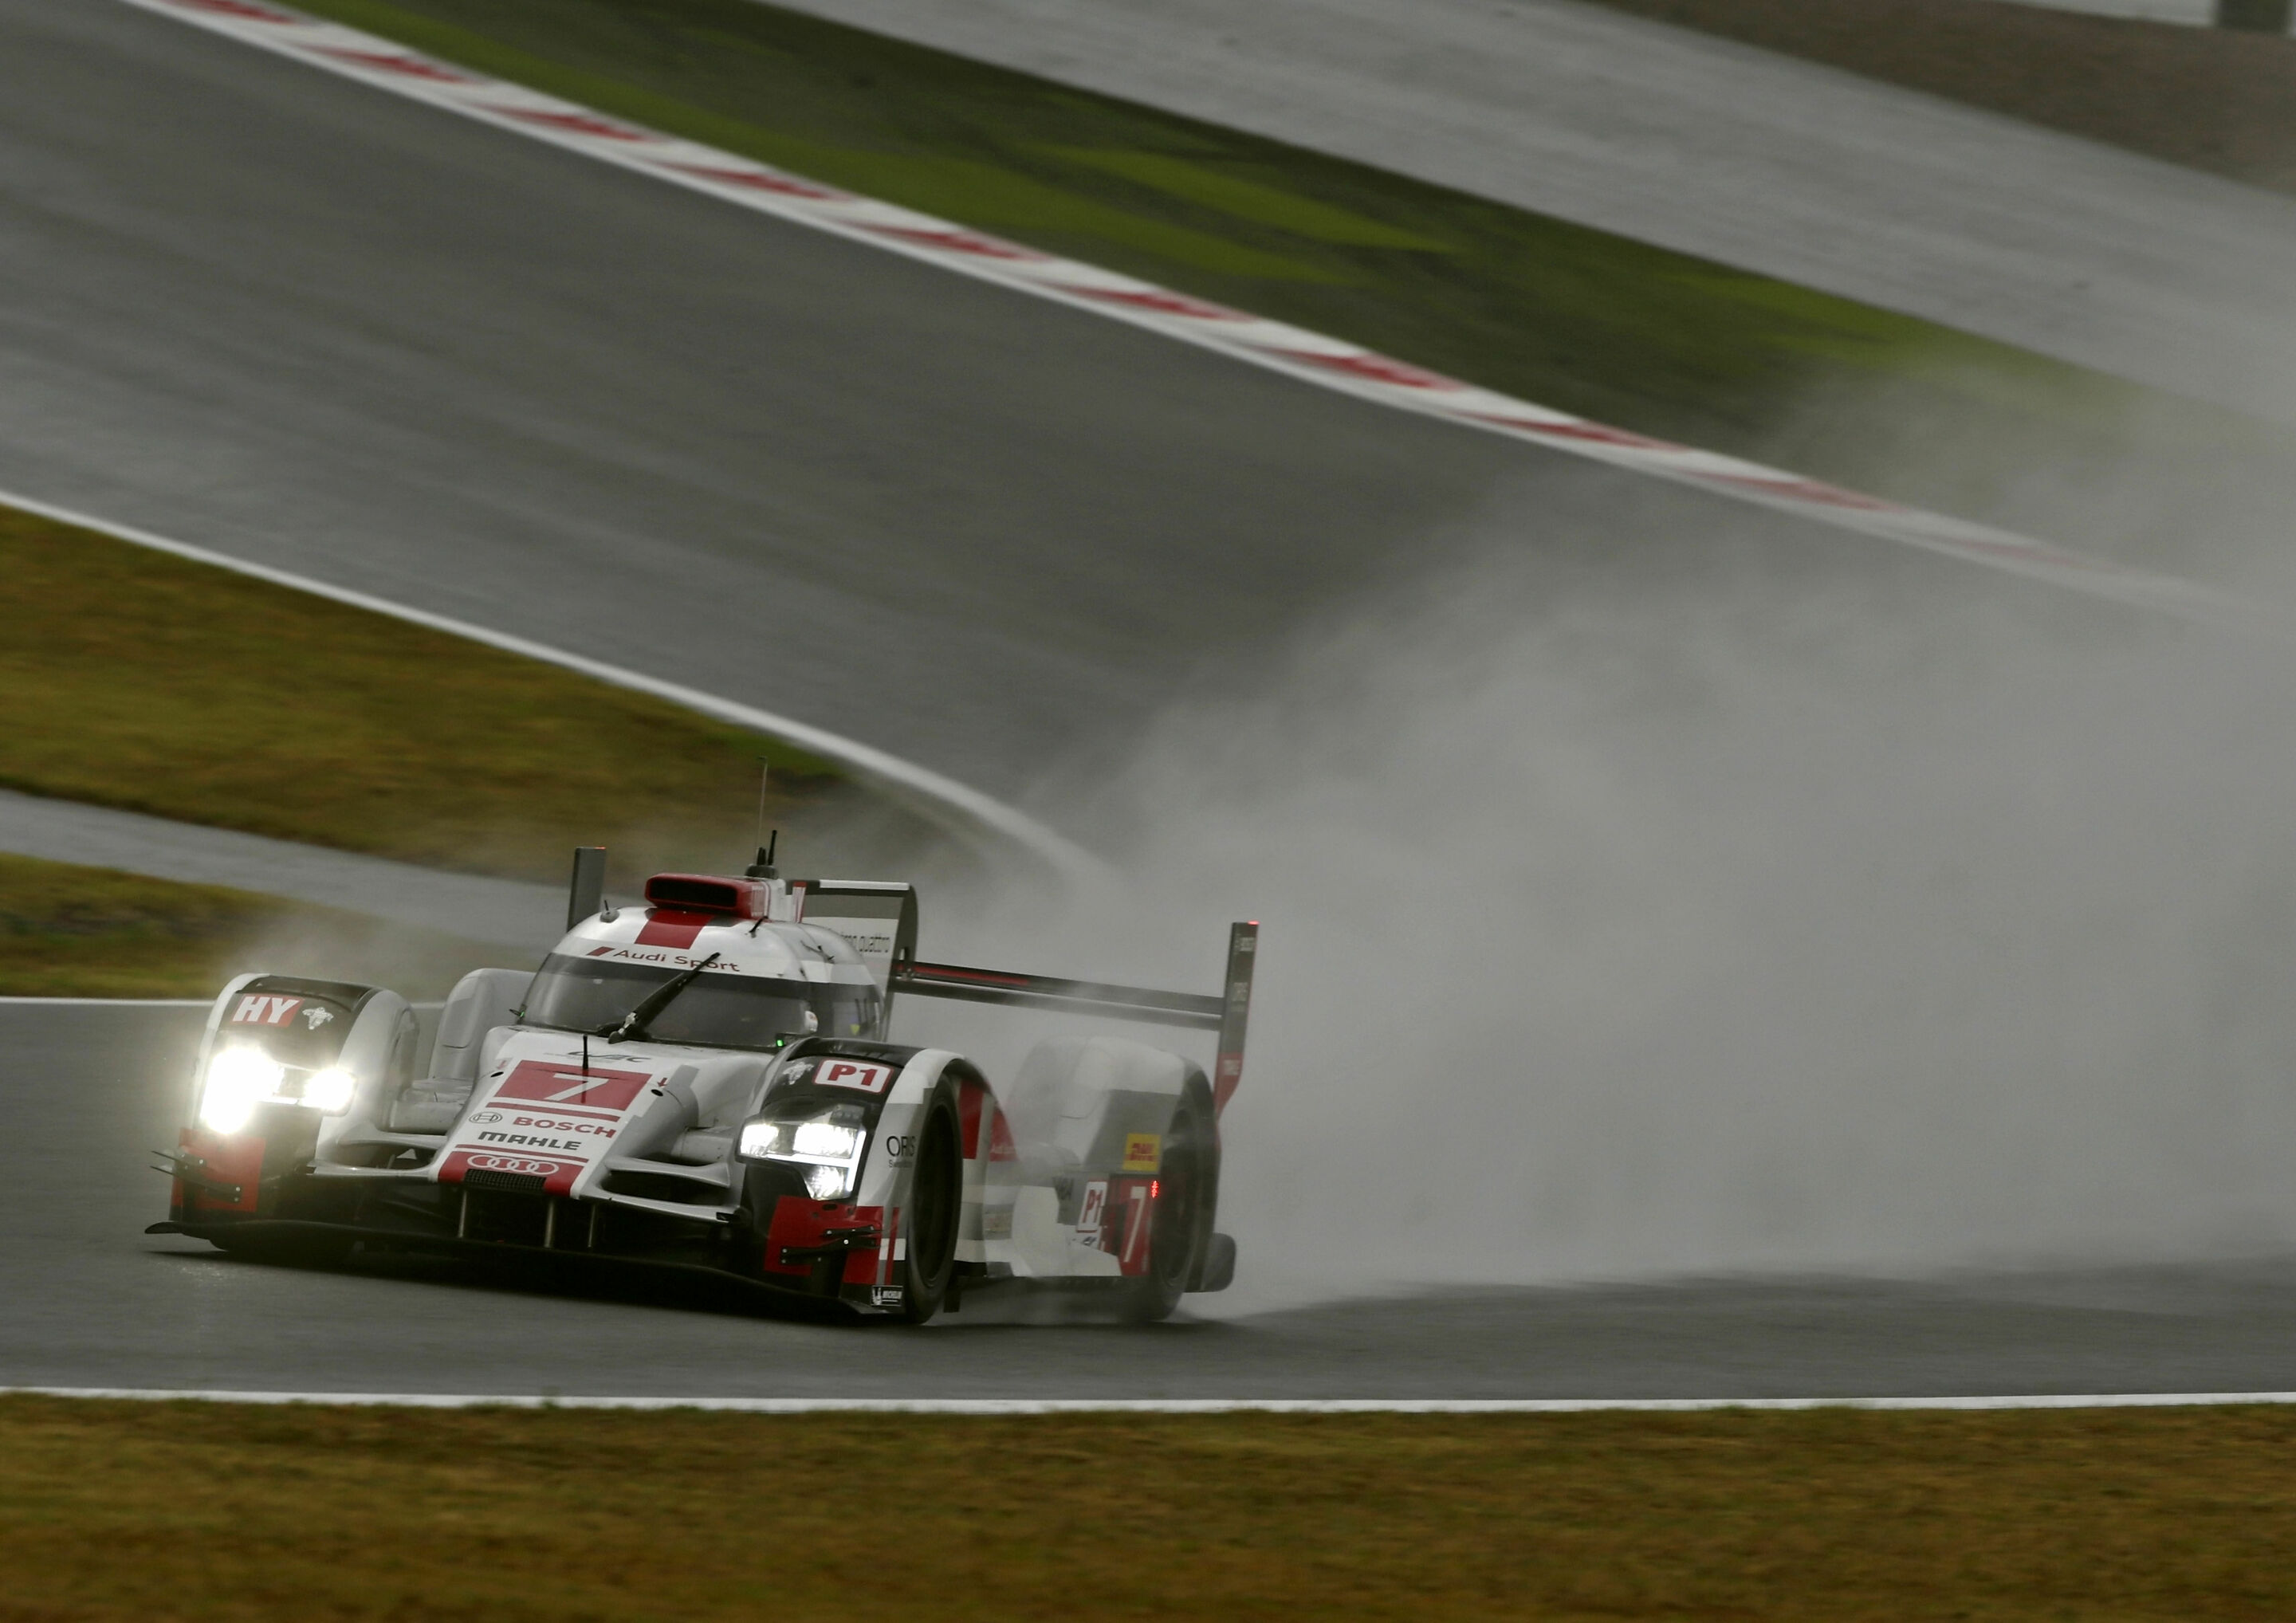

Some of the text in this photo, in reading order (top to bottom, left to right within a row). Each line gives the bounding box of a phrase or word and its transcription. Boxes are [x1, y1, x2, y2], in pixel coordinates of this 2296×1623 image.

[613, 949, 741, 972] Audi Sport
[232, 996, 300, 1024] HY
[544, 1072, 610, 1102] 7
[828, 1063, 879, 1087] P1
[513, 1116, 617, 1138] BOSCH
[478, 1131, 582, 1150] MAHLE
[1081, 1189, 1103, 1224] P1
[1123, 1185, 1147, 1263] 7
